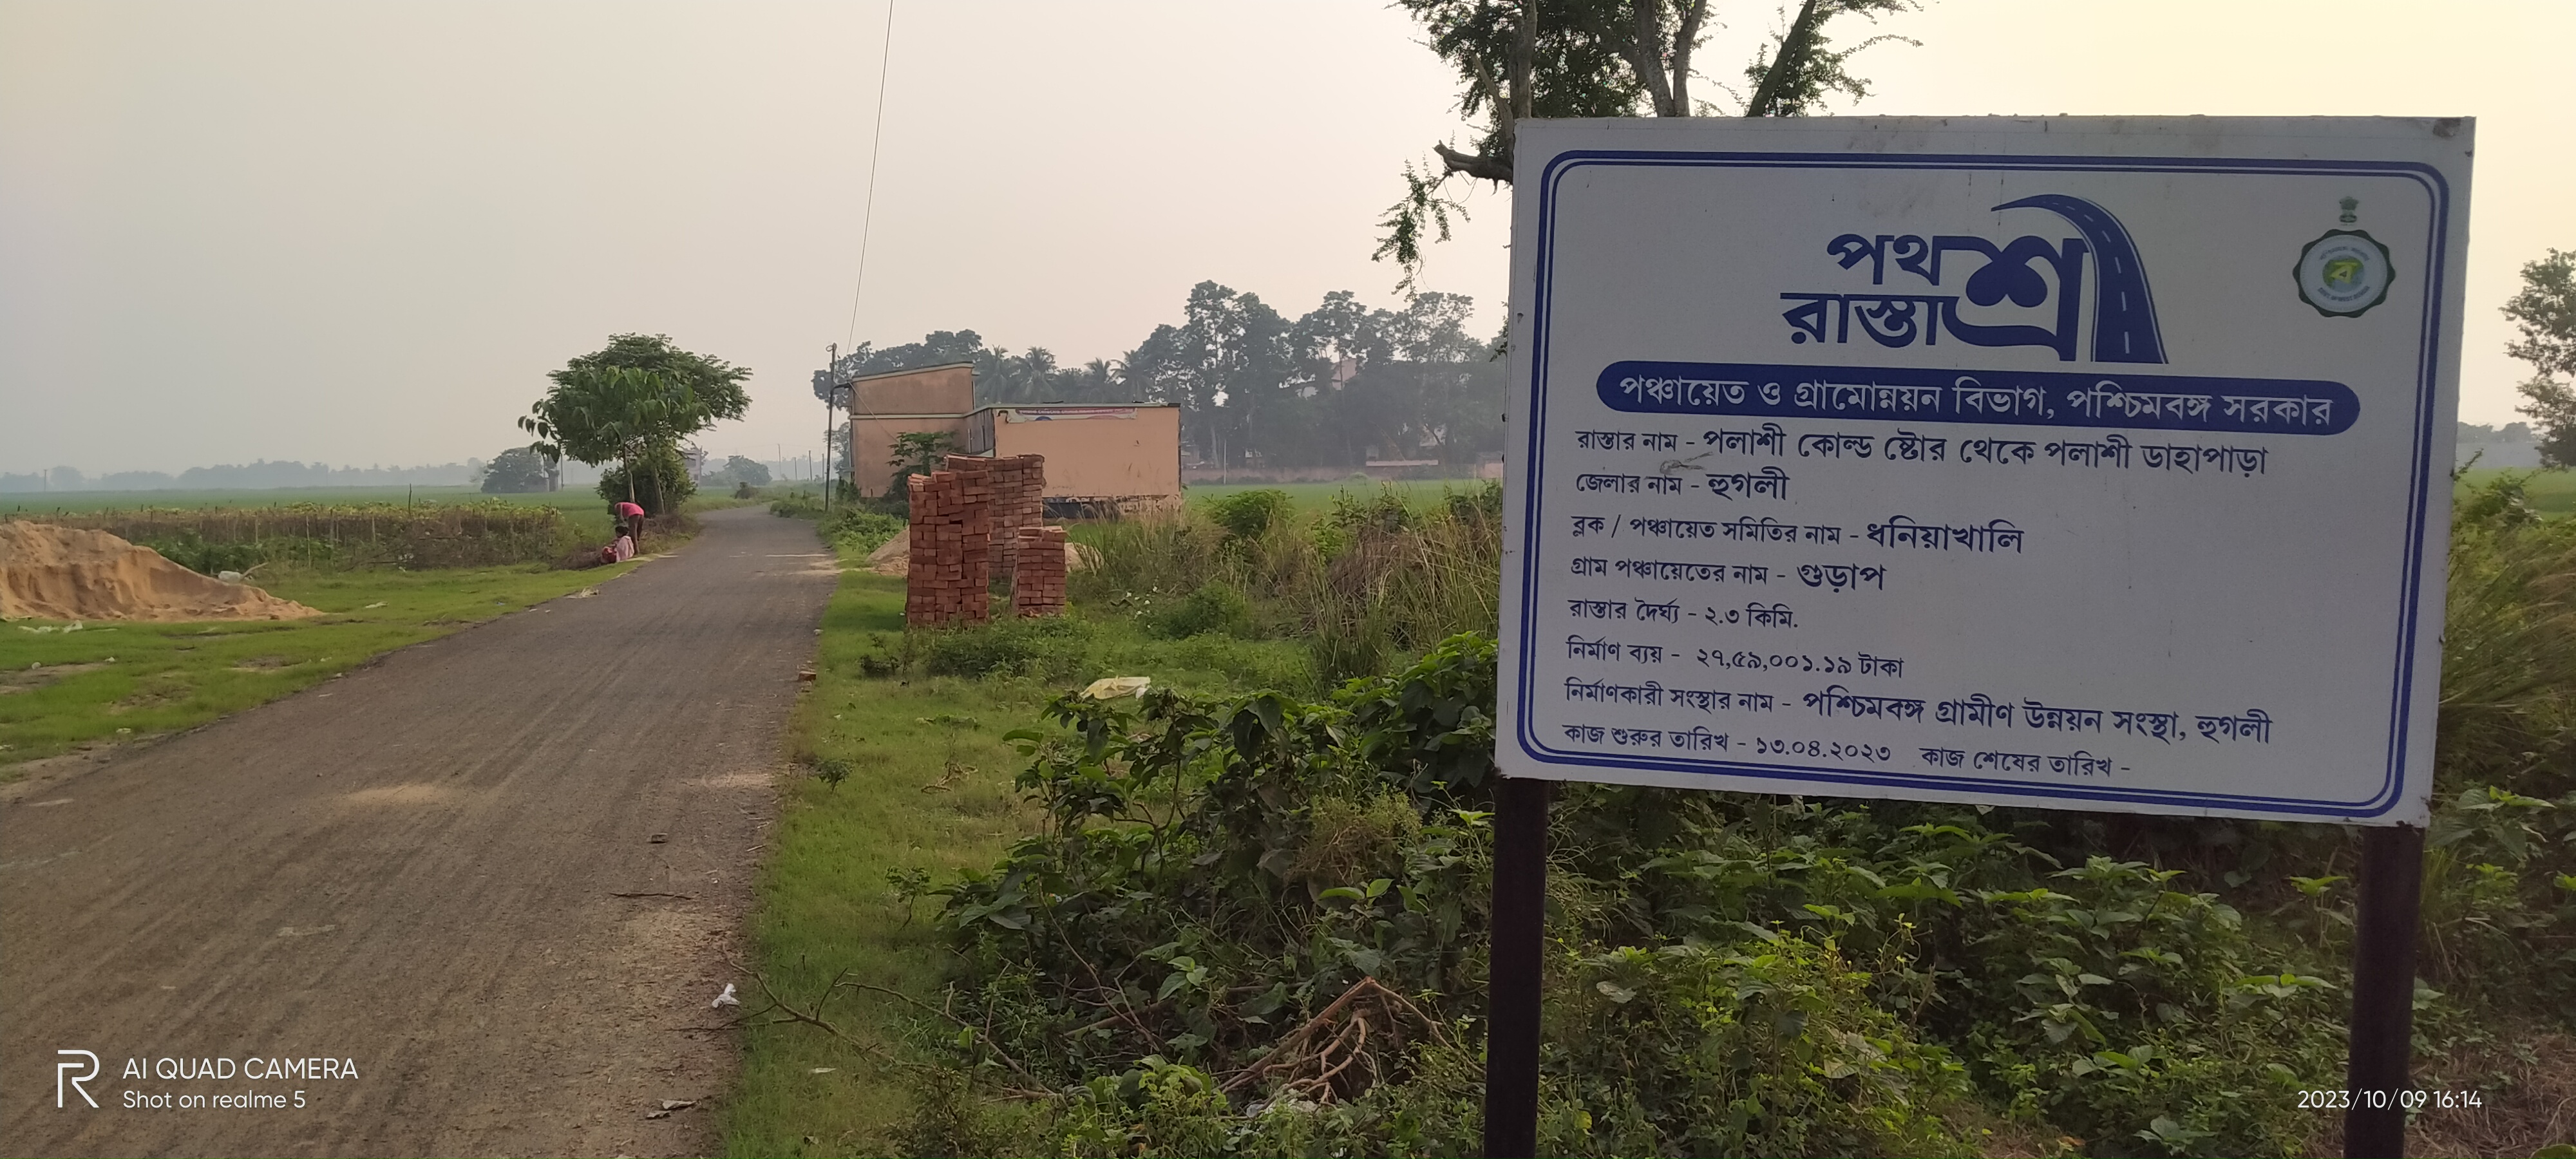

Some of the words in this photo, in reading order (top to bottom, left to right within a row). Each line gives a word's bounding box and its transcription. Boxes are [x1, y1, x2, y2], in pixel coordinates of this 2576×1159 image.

[1620, 374, 1749, 406] পঞ্চায়েত
[1757, 382, 1781, 406] ও
[1794, 379, 1943, 413] গ্রামোন্নয়ন
[1951, 376, 2054, 419] বিভাগ,
[2067, 380, 2213, 422] পশ্চিমবঙ্গ
[2221, 394, 2334, 426] সরকার
[1574, 429, 1636, 451] রাস্তার
[1641, 431, 1678, 453] নাম
[1701, 422, 1787, 457] পলাশী
[1797, 431, 1875, 459] কোল্ড
[1960, 437, 2037, 465] থেকে
[2044, 433, 2134, 469] পলাশী
[2140, 443, 2269, 478] ডাহাপাড়া
[1576, 473, 1641, 494] জেলার
[1644, 474, 1683, 495] নাম
[1705, 466, 1791, 502] হুগলী
[1570, 516, 1605, 537] ব্লক
[1611, 514, 1622, 538] /
[1629, 516, 1718, 539] পঞ্চায়েত
[1721, 516, 1799, 543] সমিতির
[1803, 524, 1842, 545] নাম
[1866, 516, 2025, 554] ধনিয়াখালি
[1571, 556, 1609, 577] গ্রাম
[1615, 558, 1727, 583] পঞ্চায়েতের
[1731, 563, 1769, 585] নাম
[1796, 563, 1888, 594] গুড়াপ
[1567, 598, 1627, 620] রাস্তার
[1705, 607, 1740, 626] ২.৩
[1745, 601, 1798, 628] কিমি.
[1565, 634, 1622, 662] নির্মাণ
[1626, 645, 1663, 664] ব্যয়
[1696, 648, 1852, 674] ২৭,৫৯,০০১.১৯
[1857, 651, 1905, 679] টাকা
[1563, 676, 1665, 707] নির্মাণকারী
[1668, 689, 1732, 715] সংস্থার
[1737, 692, 1775, 713] নাম
[1803, 684, 1927, 724] পশ্চিমবঙ্গ
[1935, 693, 2015, 728] গ্রামীণ
[2021, 697, 2104, 733] উন্নয়ন
[2110, 711, 2186, 746] সংস্থা,
[2194, 708, 2273, 744] হুগলী
[1562, 723, 1605, 745] কাজ
[1611, 728, 1663, 748] শুরুর
[1667, 725, 1730, 753] তারিখ
[1756, 737, 1891, 764] ১৩.০৪.২০২৩
[1918, 746, 1966, 769] কাজ
[1973, 749, 2042, 773] শেষের
[2047, 750, 2113, 777] তারিখ
